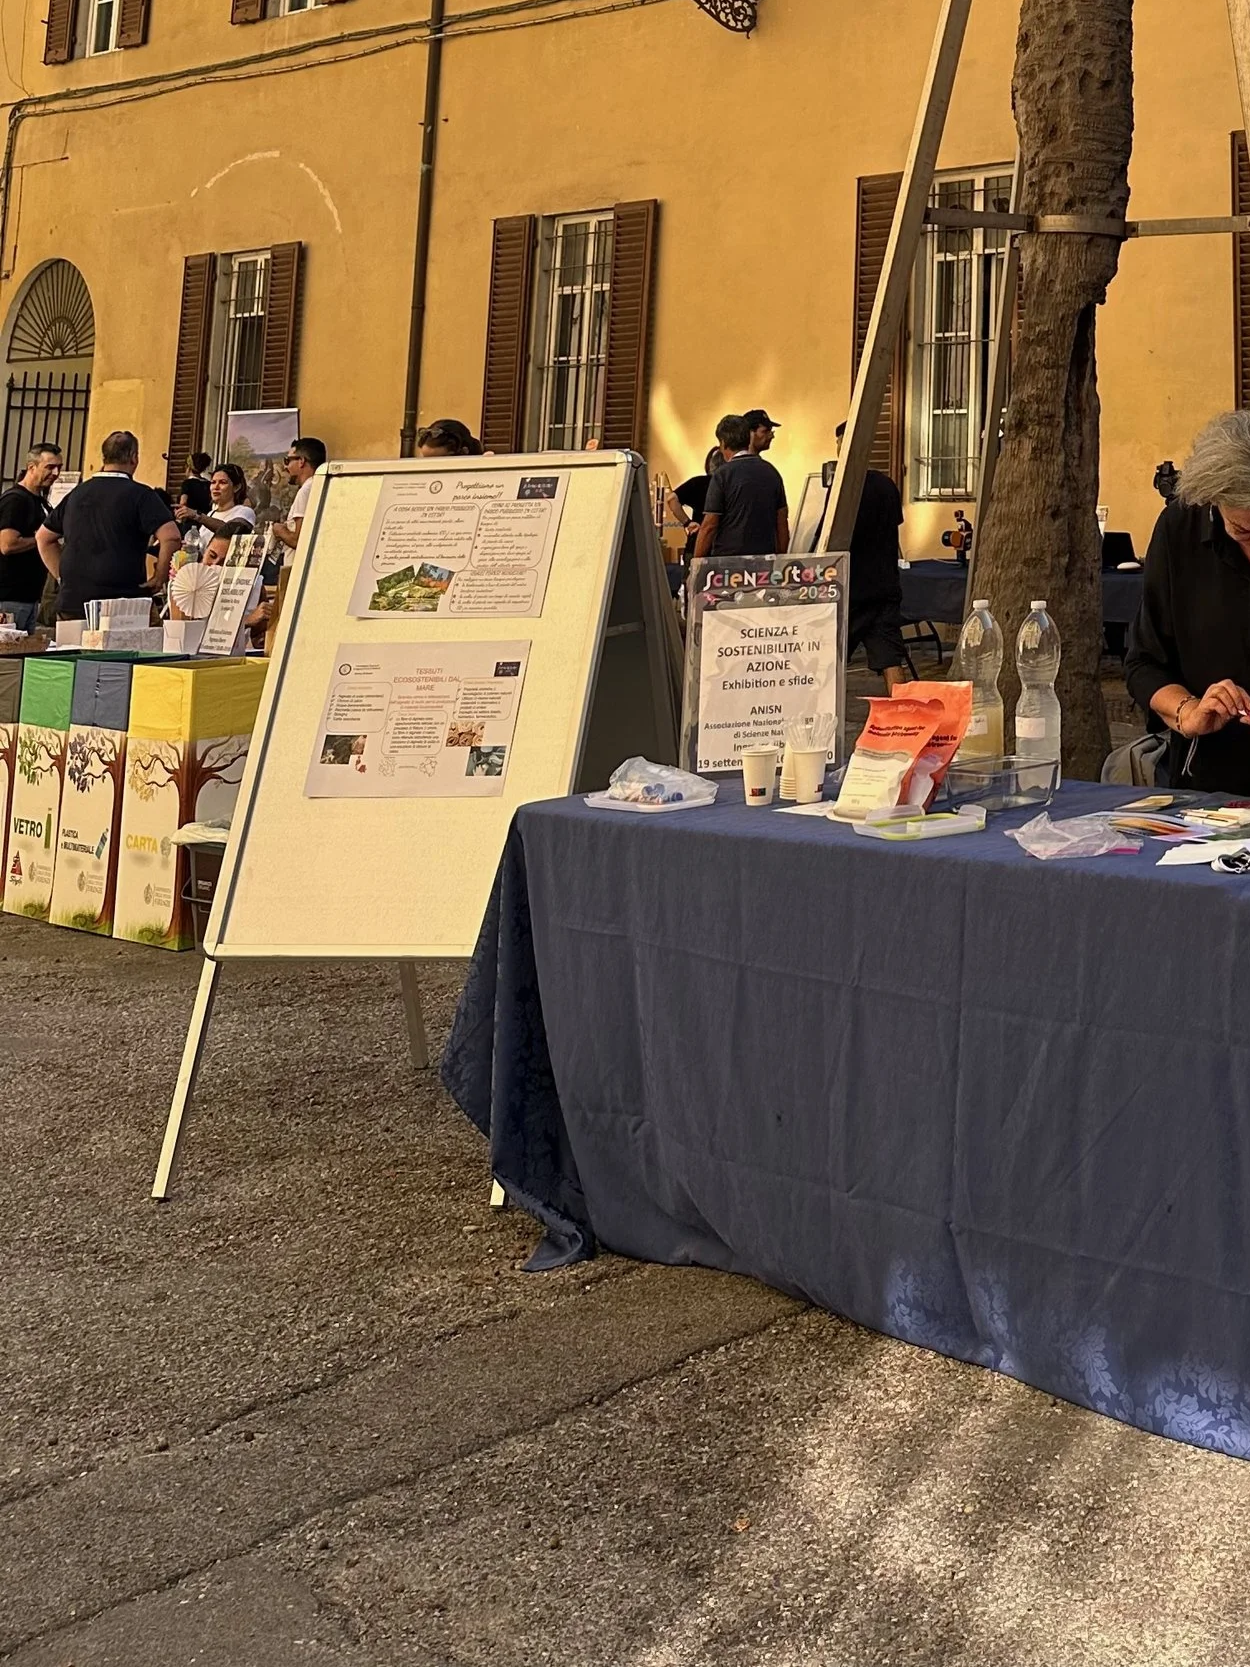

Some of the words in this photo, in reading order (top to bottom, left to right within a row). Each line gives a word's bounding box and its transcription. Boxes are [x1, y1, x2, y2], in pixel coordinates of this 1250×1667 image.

[799, 584, 837, 599] 2025
[740, 626, 789, 639] SCIENZA
[792, 625, 798, 636] E
[808, 641, 821, 652] IN
[416, 667, 443, 675] TESSUTI
[746, 660, 791, 673] AZIONE
[722, 678, 776, 691] Exhibition
[788, 675, 814, 686] sfide
[750, 705, 782, 716] ANISN
[704, 721, 751, 730] Associazione
[733, 731, 740, 739] di
[742, 730, 769, 738] Scienze
[698, 759, 710, 769] 19
[13, 817, 43, 838] VETRO
[62, 828, 79, 839] PLASTICA
[125, 834, 158, 854] CARTA
